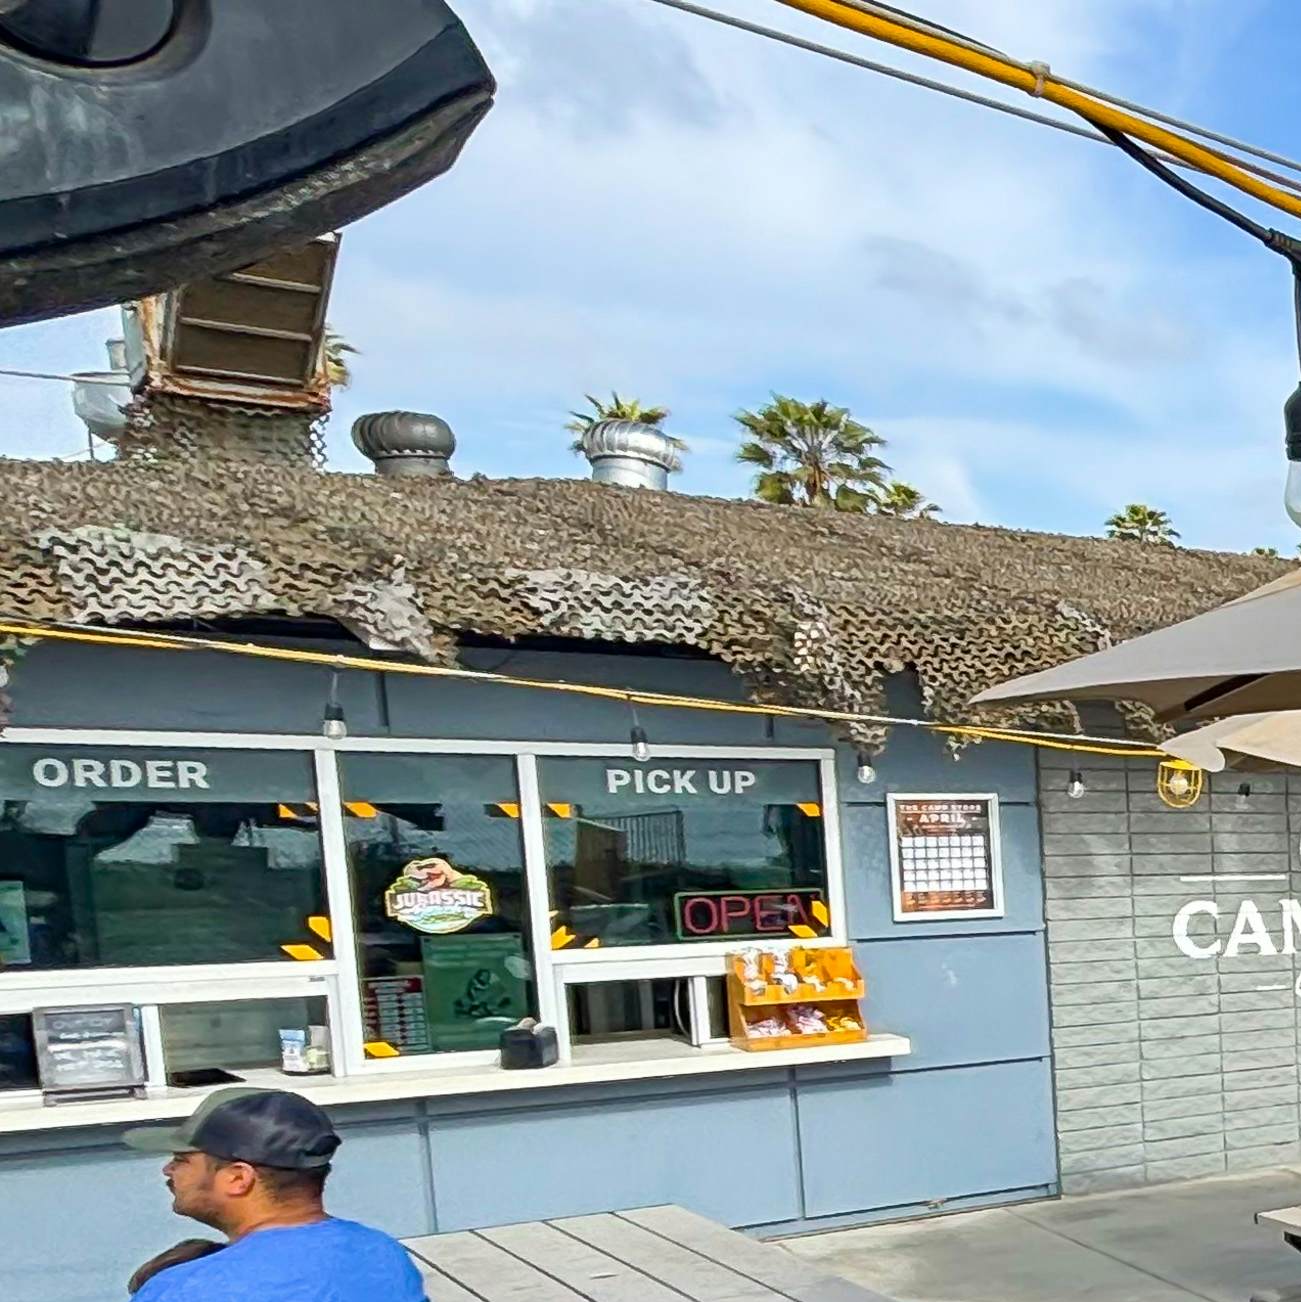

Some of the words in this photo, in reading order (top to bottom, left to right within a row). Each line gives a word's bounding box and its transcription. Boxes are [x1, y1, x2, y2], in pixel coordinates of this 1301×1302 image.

[32, 758, 210, 789] ORDER
[606, 769, 697, 794] PICK
[708, 770, 755, 794] UP
[919, 813, 965, 823] APRIL
